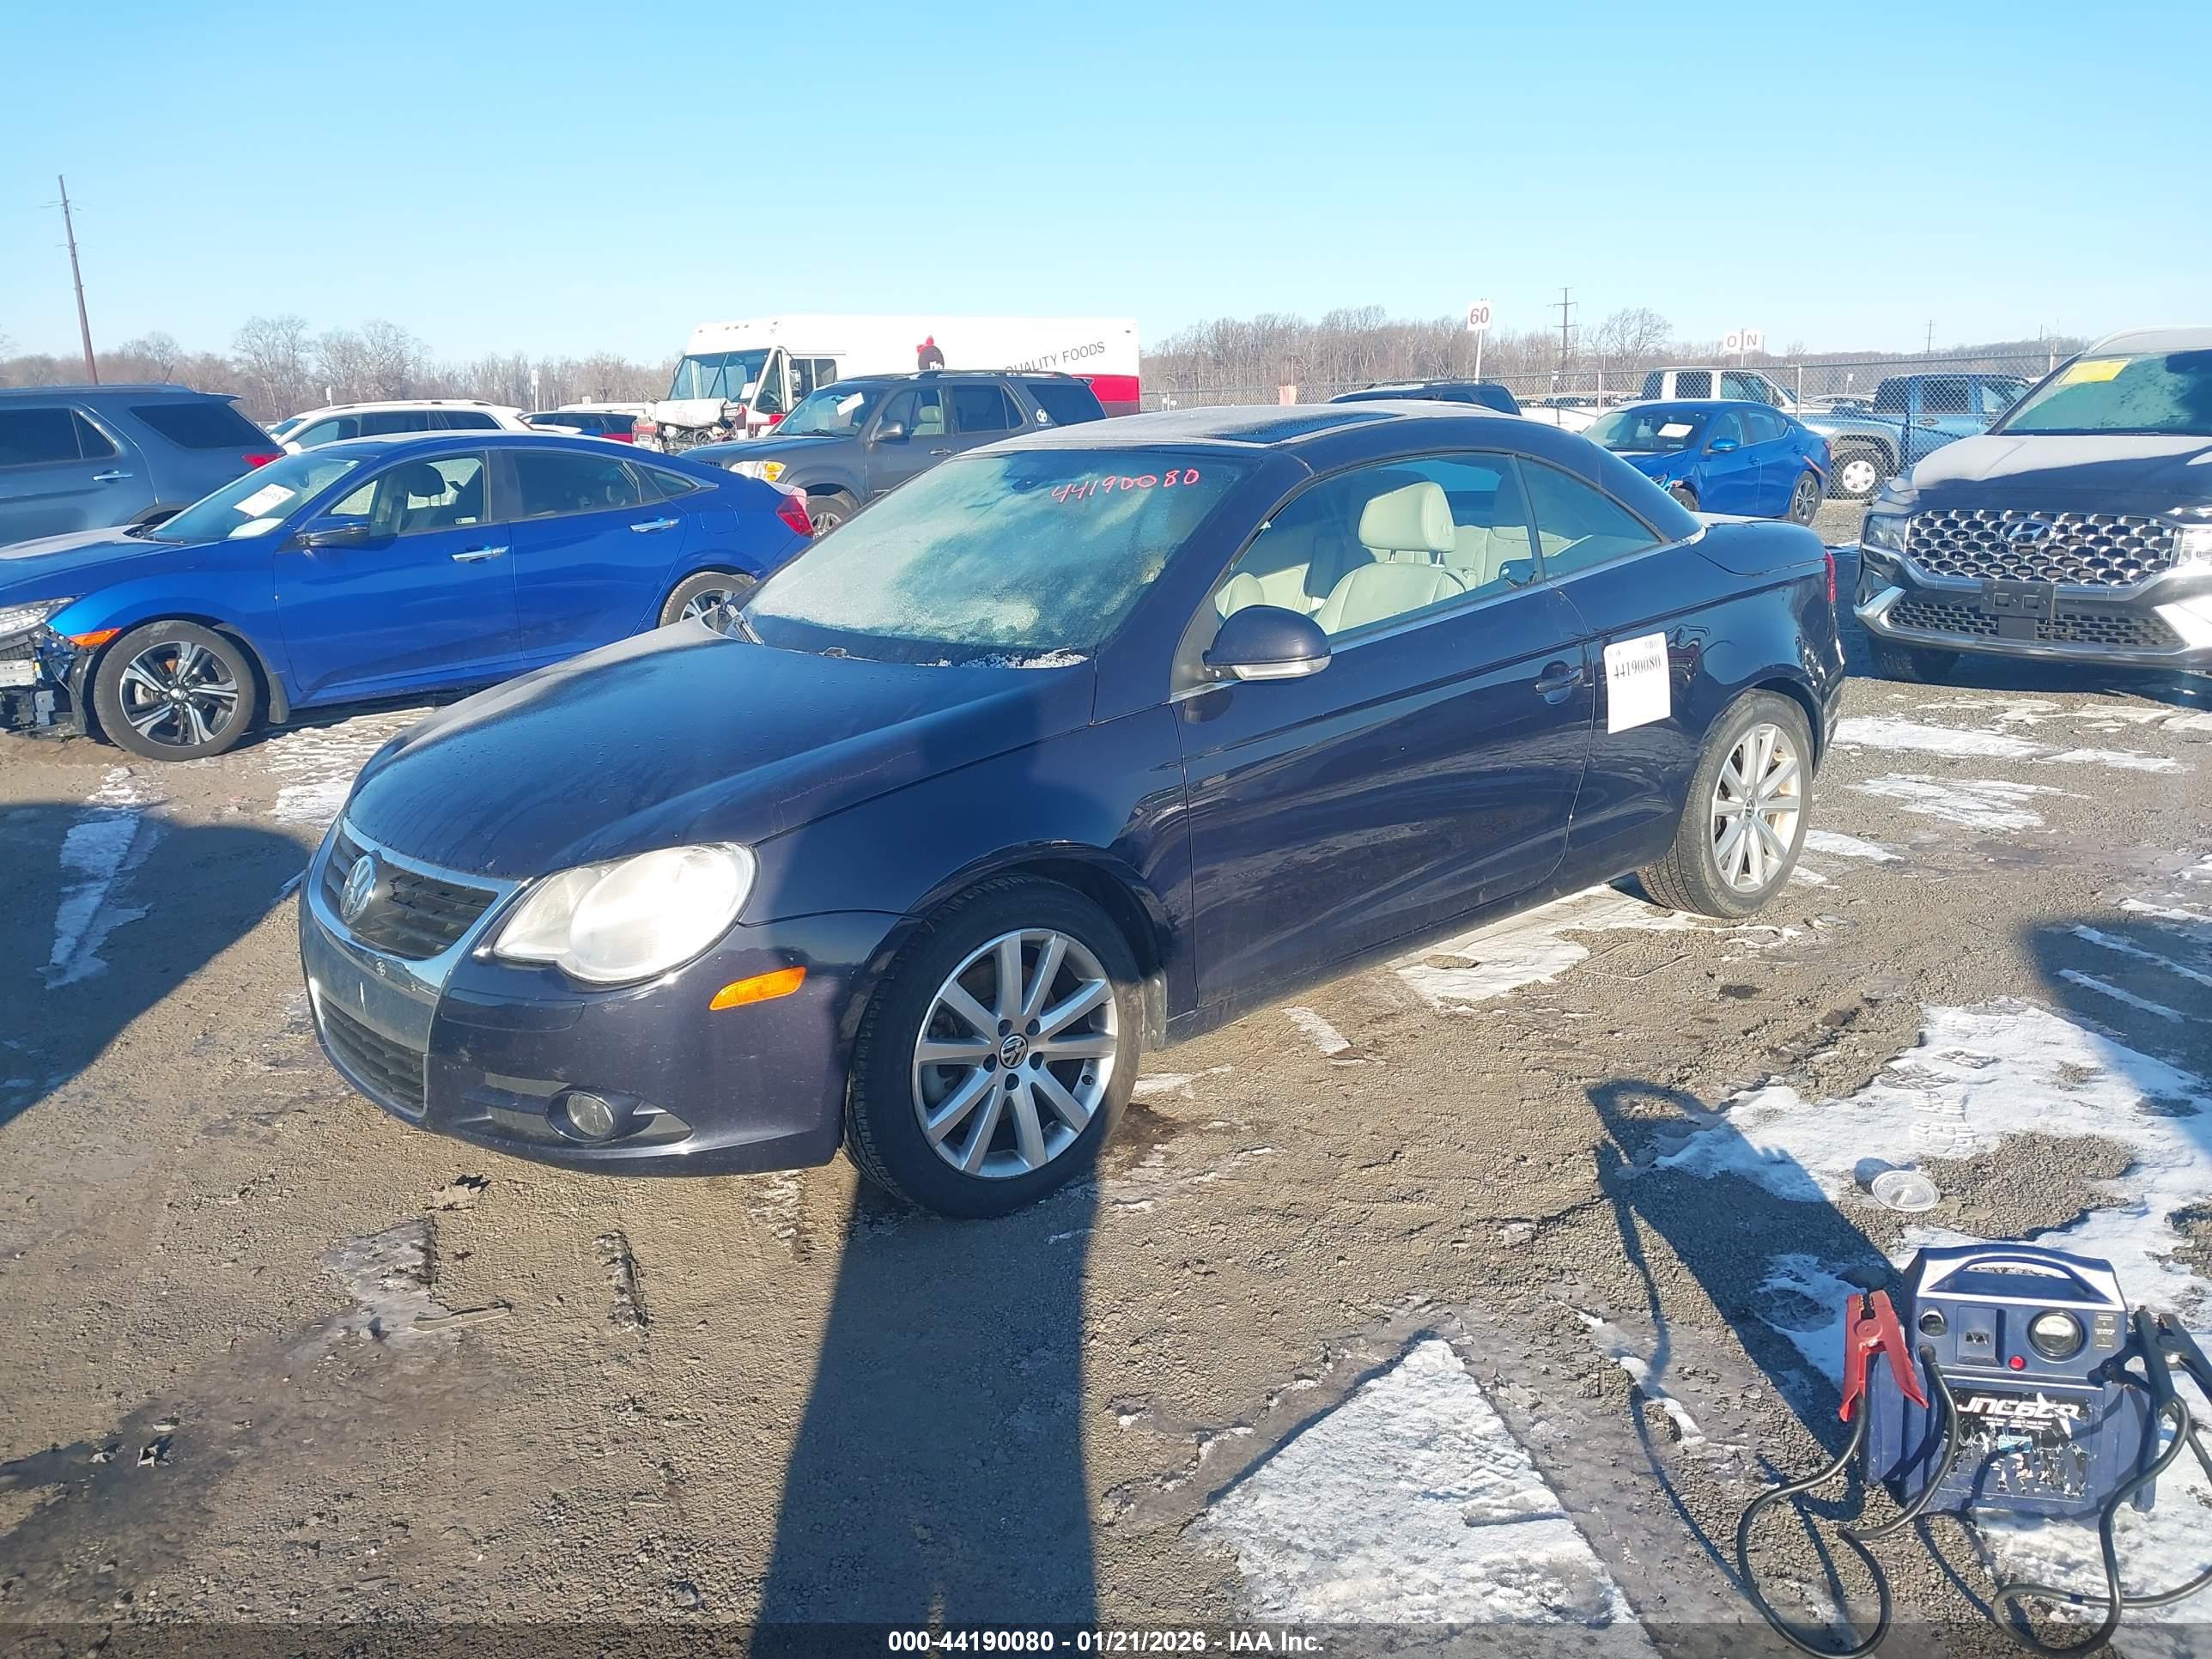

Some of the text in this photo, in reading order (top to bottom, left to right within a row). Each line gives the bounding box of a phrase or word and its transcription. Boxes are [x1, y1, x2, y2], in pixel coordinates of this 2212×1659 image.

[1469, 307, 1490, 325] 60
[1062, 341, 1106, 362] FOODS
[1051, 469, 1200, 502] 44190080
[1613, 653, 1662, 679] 44190080
